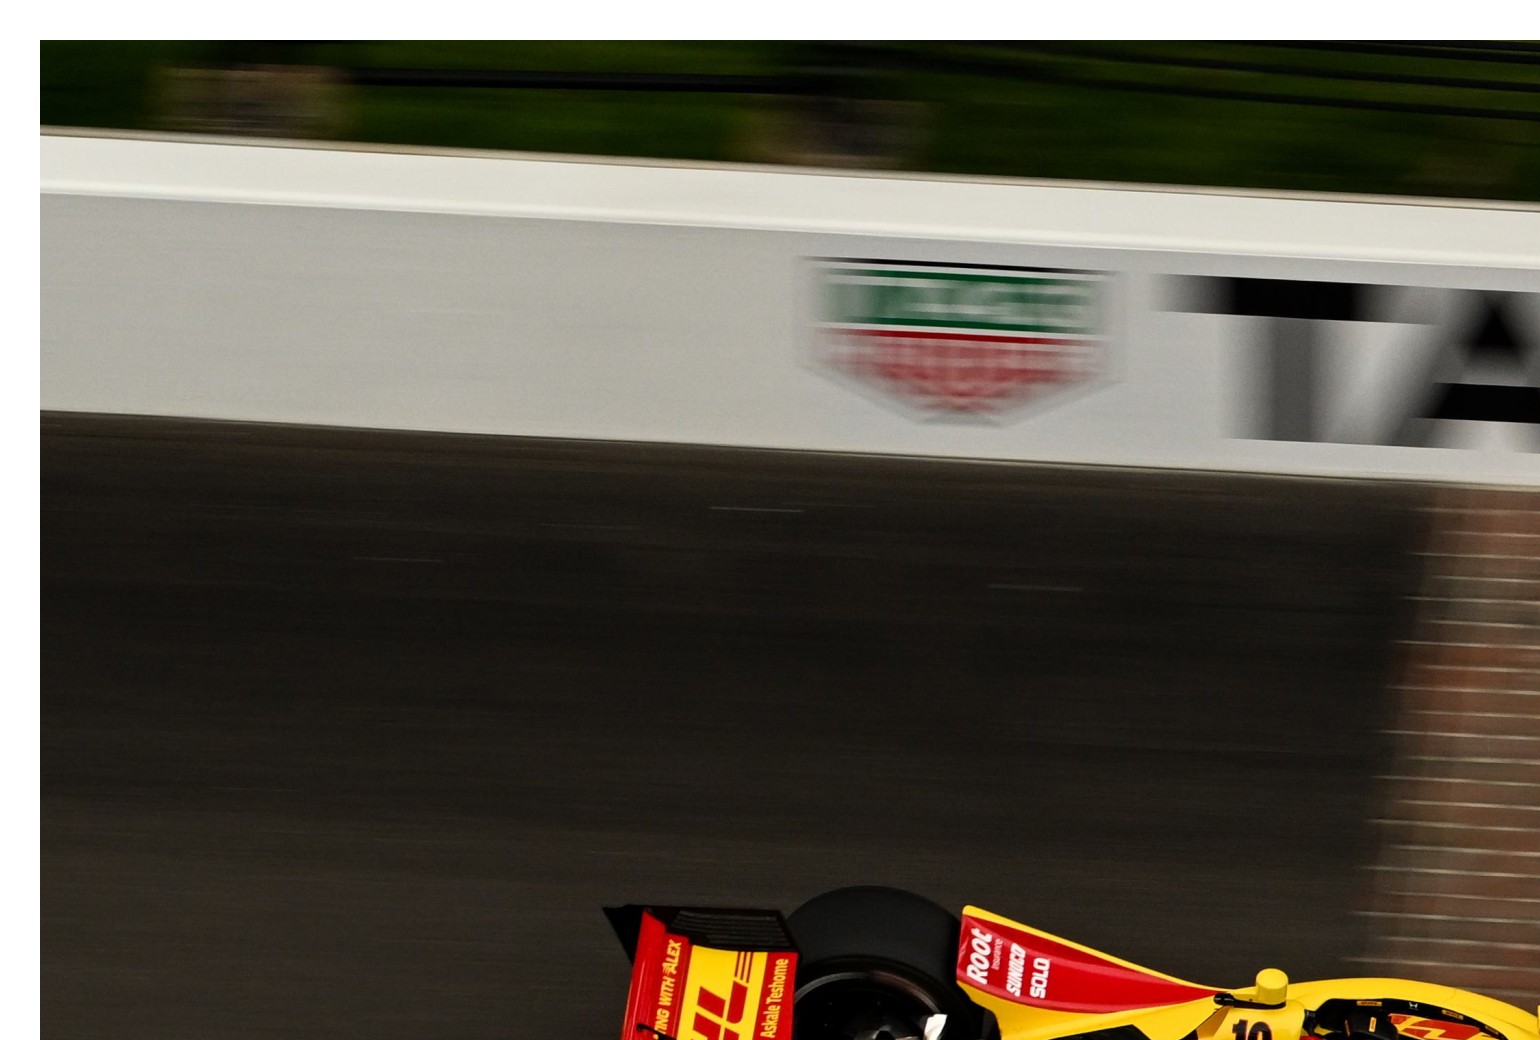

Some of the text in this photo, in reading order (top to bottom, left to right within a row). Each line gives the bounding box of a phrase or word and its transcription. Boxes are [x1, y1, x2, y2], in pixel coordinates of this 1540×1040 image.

[662, 939, 682, 975] ALEX
[1006, 942, 1027, 997] SUNOCO
[1030, 957, 1050, 999] SOLO
[659, 976, 676, 1006] WITH
[760, 958, 789, 1039] Askale Teshome
